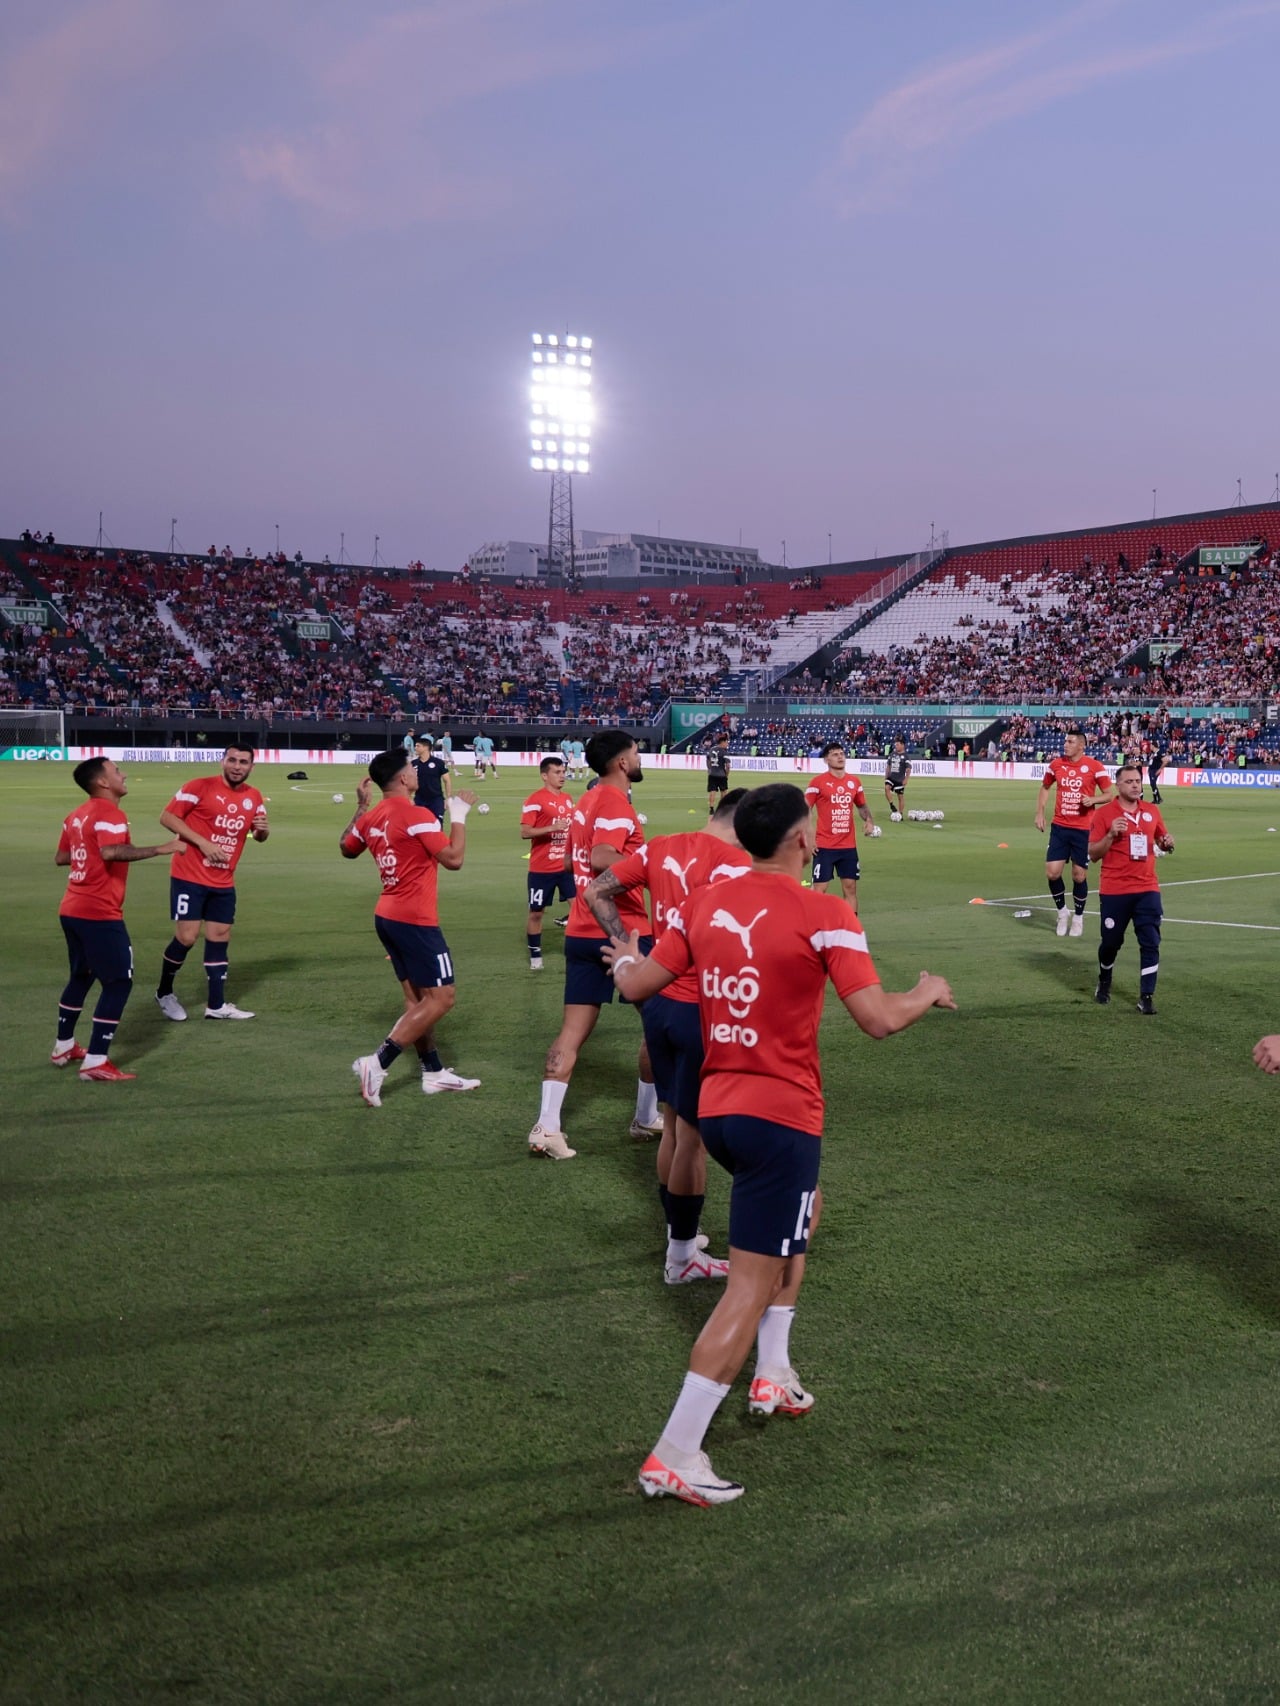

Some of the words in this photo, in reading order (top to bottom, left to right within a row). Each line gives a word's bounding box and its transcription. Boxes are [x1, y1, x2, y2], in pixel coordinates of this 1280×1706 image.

[1206, 551, 1253, 560] SALID
[9, 610, 43, 623] ALIDA
[1184, 771, 1209, 784] FIFA
[1214, 772, 1254, 786] WORLD
[1257, 773, 1280, 786] CUP
[177, 894, 190, 914] 6
[530, 888, 543, 905] 14
[437, 952, 453, 979] 11
